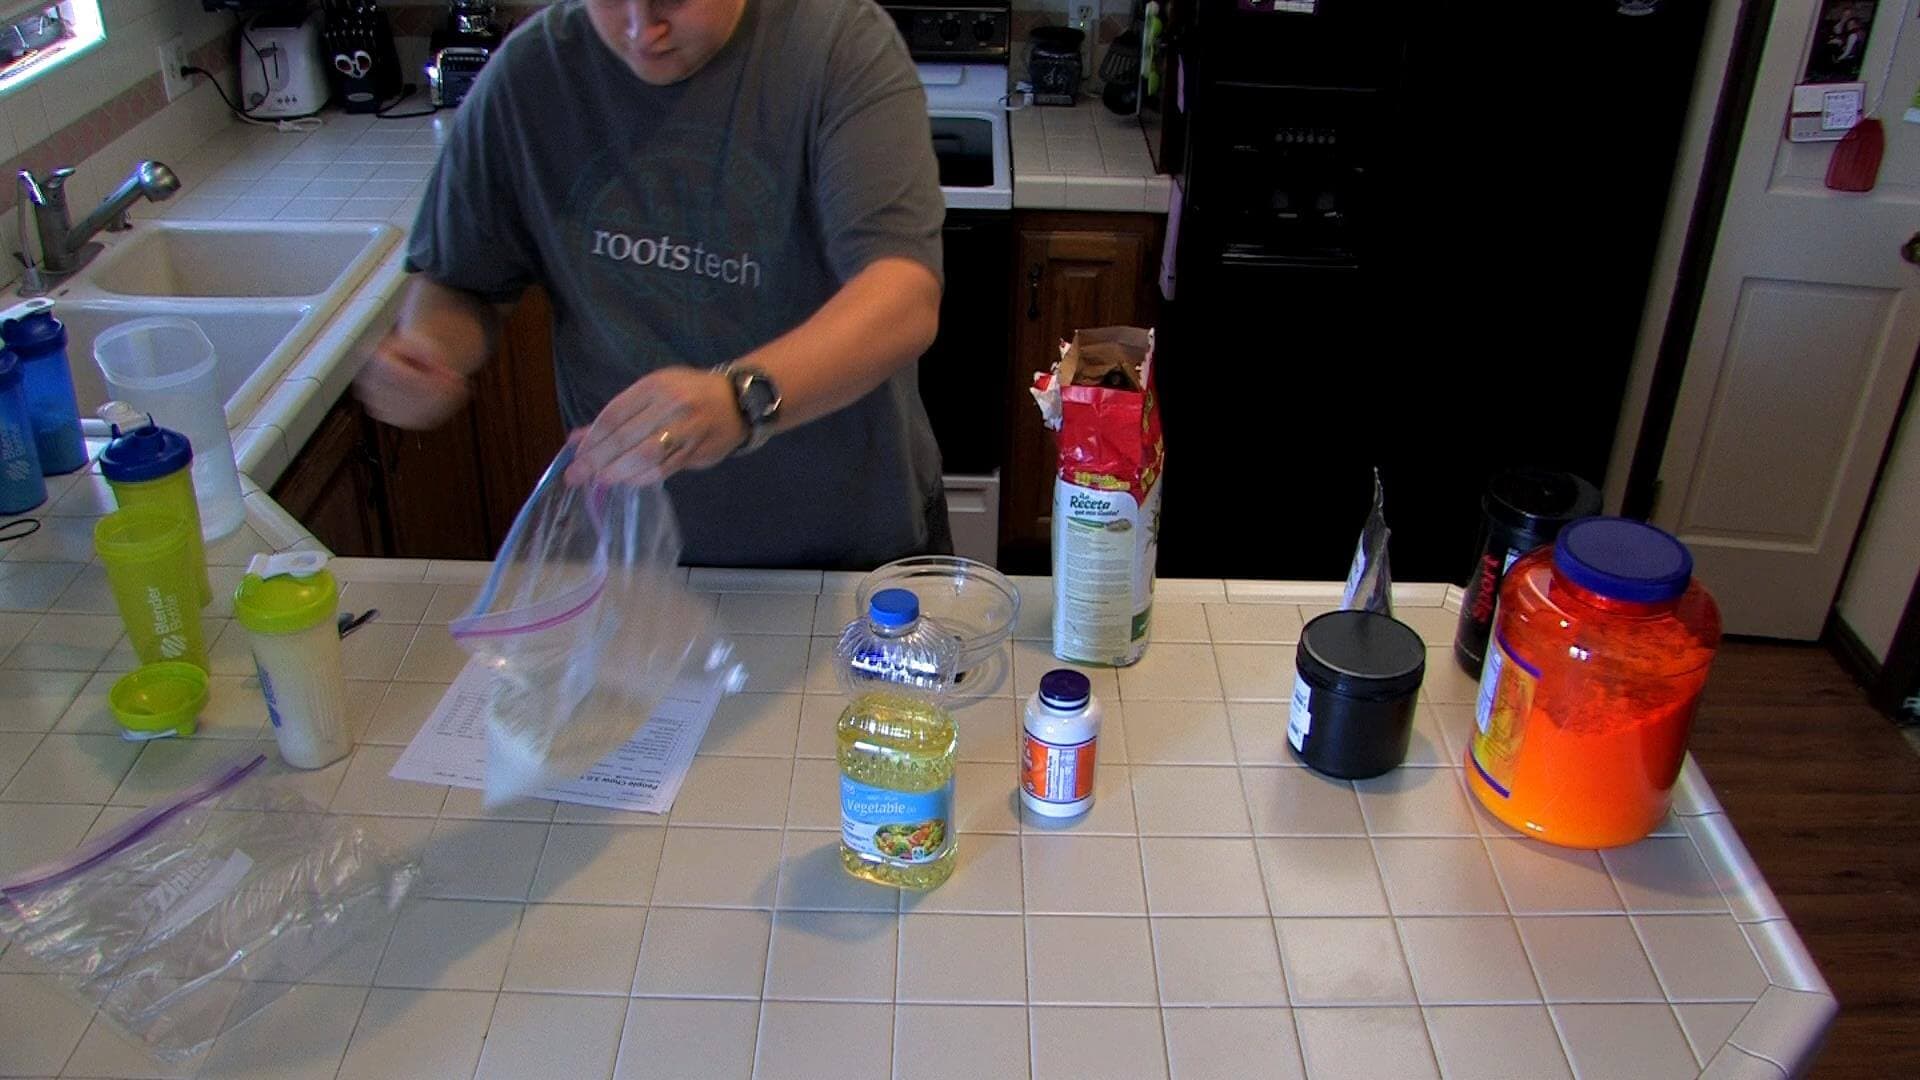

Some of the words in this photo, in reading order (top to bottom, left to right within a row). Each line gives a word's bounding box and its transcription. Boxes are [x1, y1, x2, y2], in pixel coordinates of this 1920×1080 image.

[592, 230, 761, 287] rootstech
[1070, 495, 1111, 509] Receta
[147, 586, 169, 635] Blender
[602, 776, 626, 786] Chow
[628, 781, 658, 790] People
[846, 799, 905, 815] Vegetable
